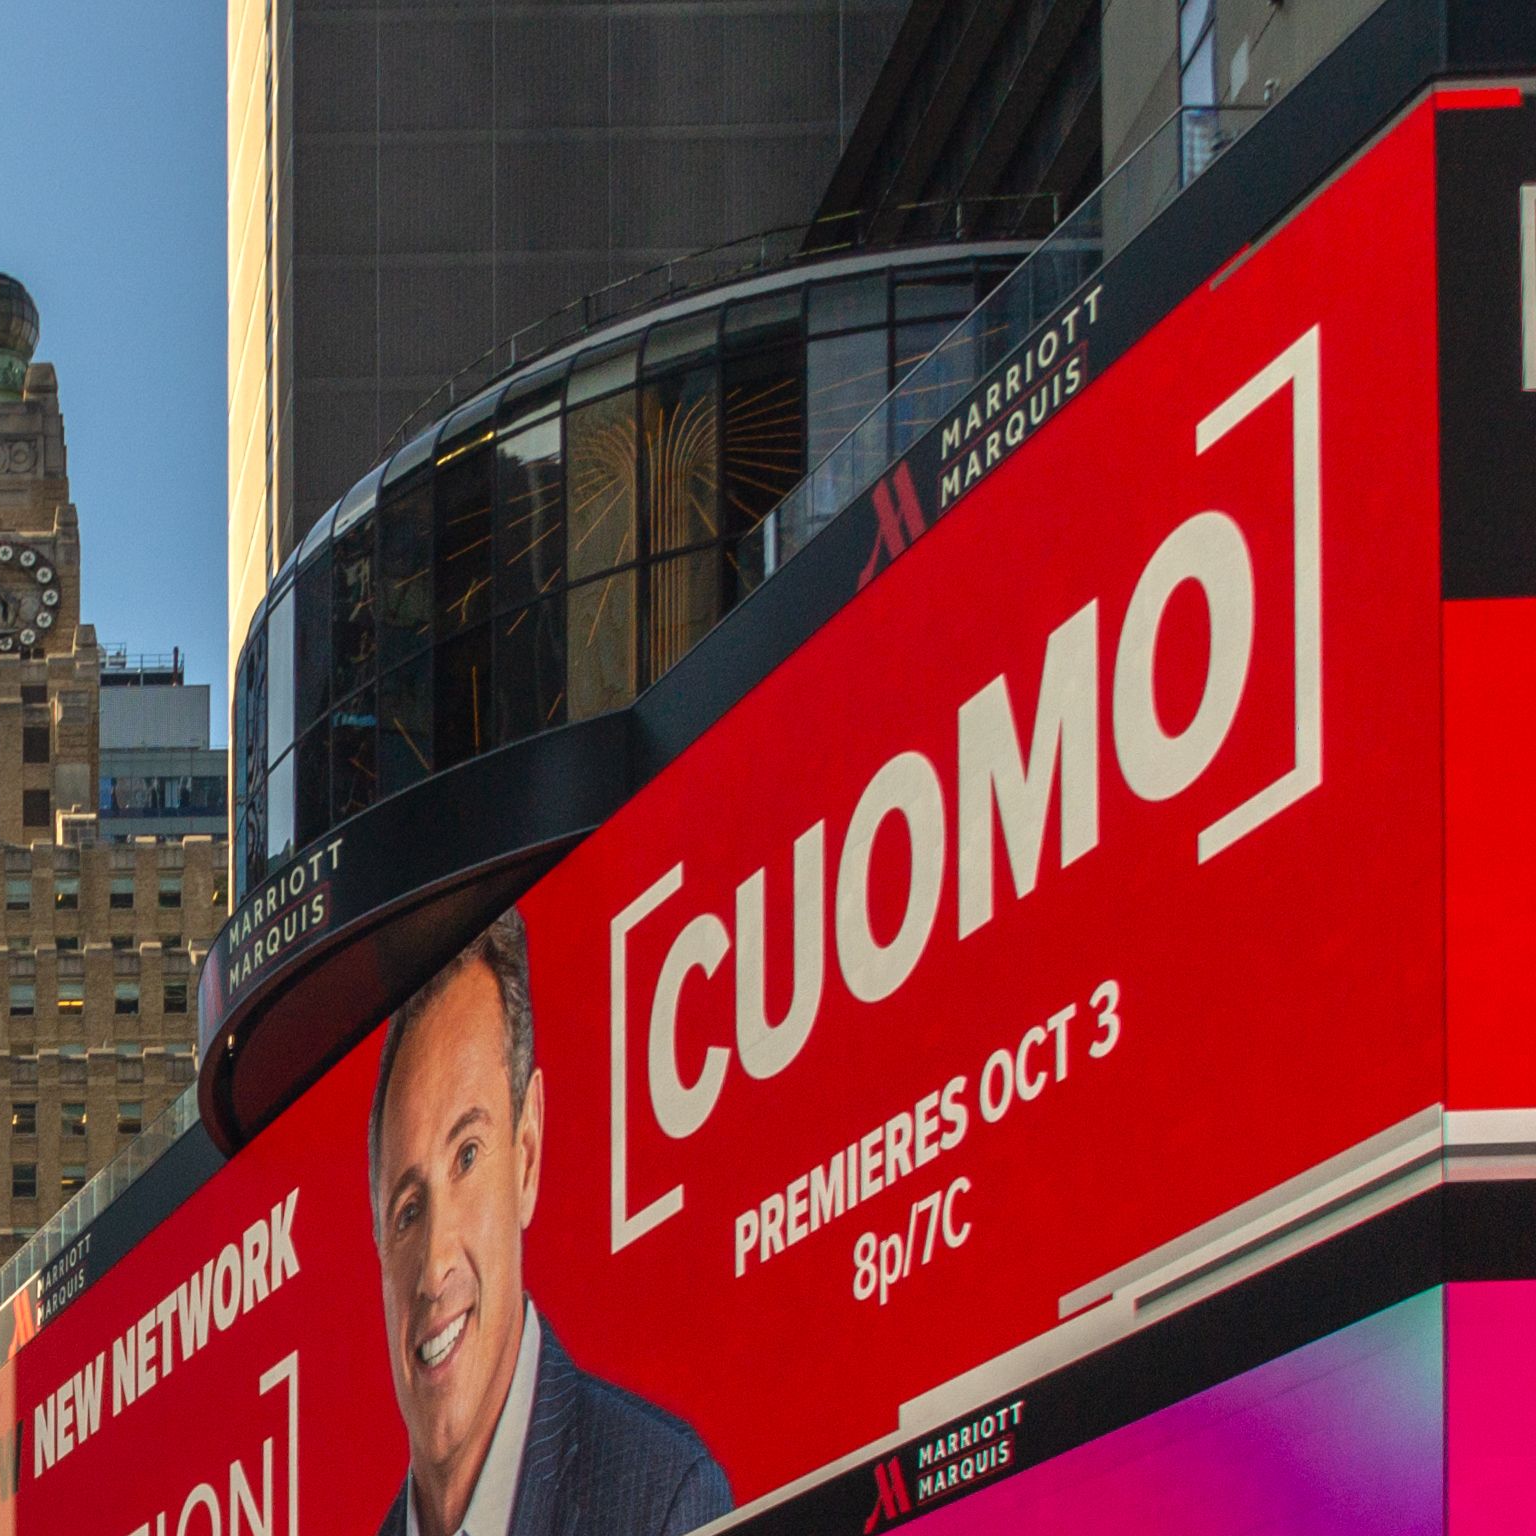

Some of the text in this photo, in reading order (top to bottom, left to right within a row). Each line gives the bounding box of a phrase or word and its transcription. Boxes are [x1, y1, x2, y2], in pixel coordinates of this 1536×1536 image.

[940, 360, 1081, 507] MARQUIS
[941, 285, 1101, 459] MARRIOTT
[230, 838, 342, 952] MARRIOTT
[648, 511, 1255, 1138] CUOMO
[230, 894, 324, 994] MARQUIS
[734, 979, 1121, 1276] PREMIERES OCT 3
[852, 1176, 972, 1304] 8p/7C
[34, 1187, 300, 1478] NEW NETWORK
